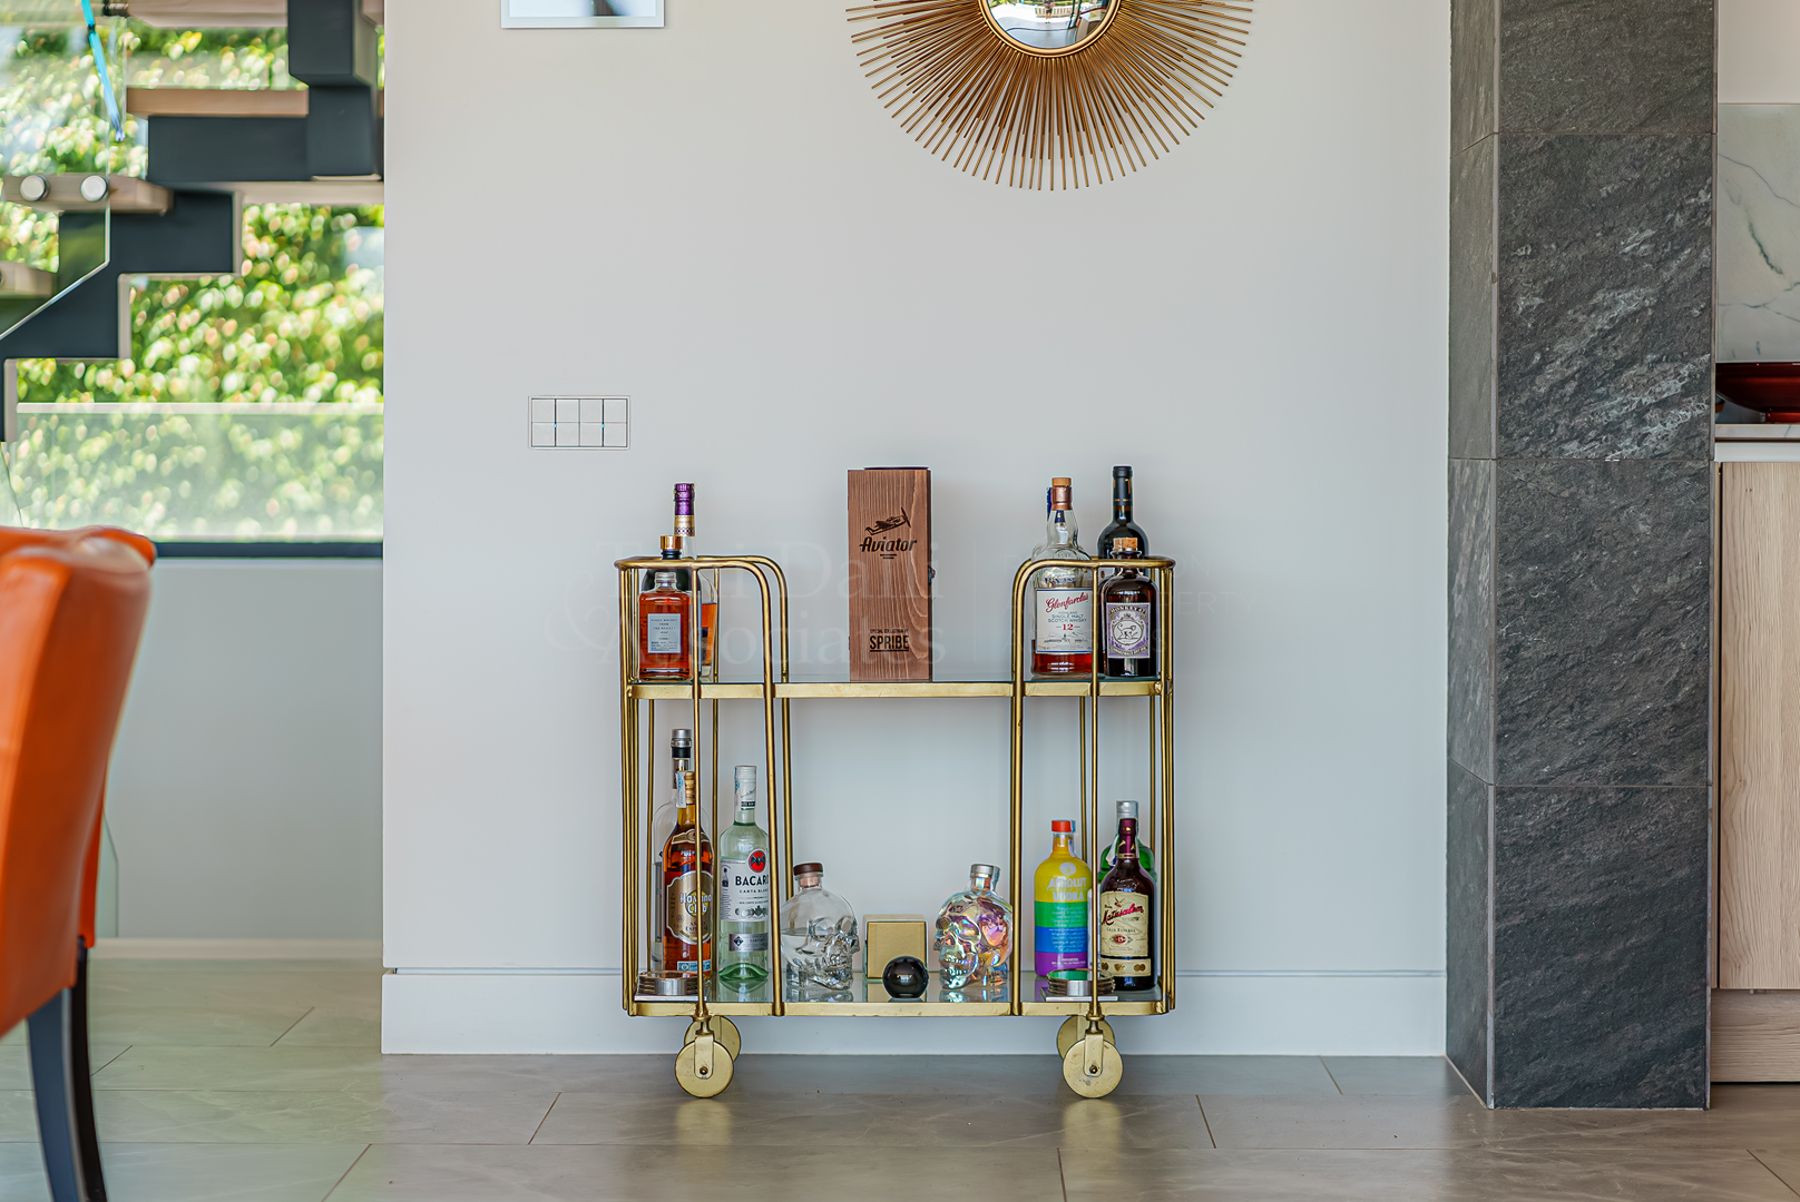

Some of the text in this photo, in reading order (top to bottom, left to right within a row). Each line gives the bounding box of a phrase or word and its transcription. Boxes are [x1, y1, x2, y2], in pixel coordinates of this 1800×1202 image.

[859, 536, 918, 553] Aviator
[1061, 623, 1074, 631] 12
[869, 635, 910, 650] SPRIBE
[680, 892, 713, 904] Havna
[687, 903, 708, 914] Clb
